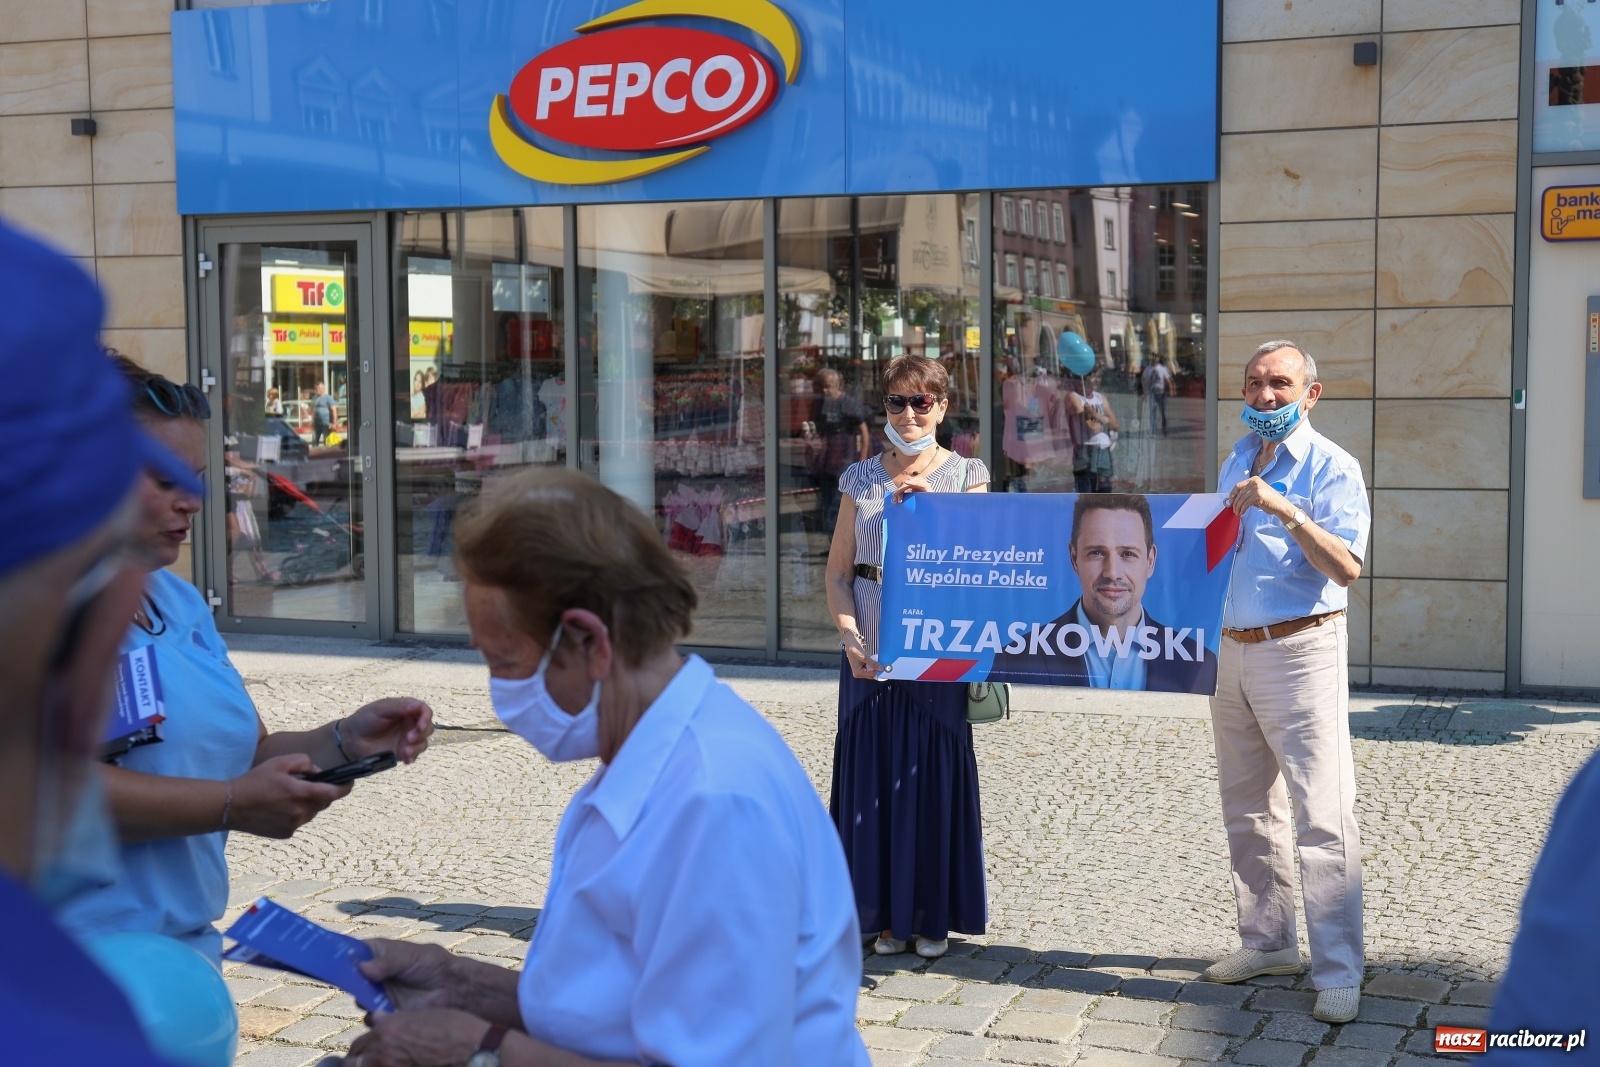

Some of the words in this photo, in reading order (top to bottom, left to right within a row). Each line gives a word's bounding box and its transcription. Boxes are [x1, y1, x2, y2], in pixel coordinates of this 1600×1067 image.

[535, 54, 746, 120] PEPCO
[905, 544, 948, 565] Silny
[953, 545, 1044, 565] Prezydent
[906, 567, 983, 588] Wspólna
[988, 569, 1048, 587] Polska
[903, 608, 924, 616] RAFAŁ
[902, 618, 1205, 662] TRZASKOWSKI
[134, 656, 151, 707] KONTAKT
